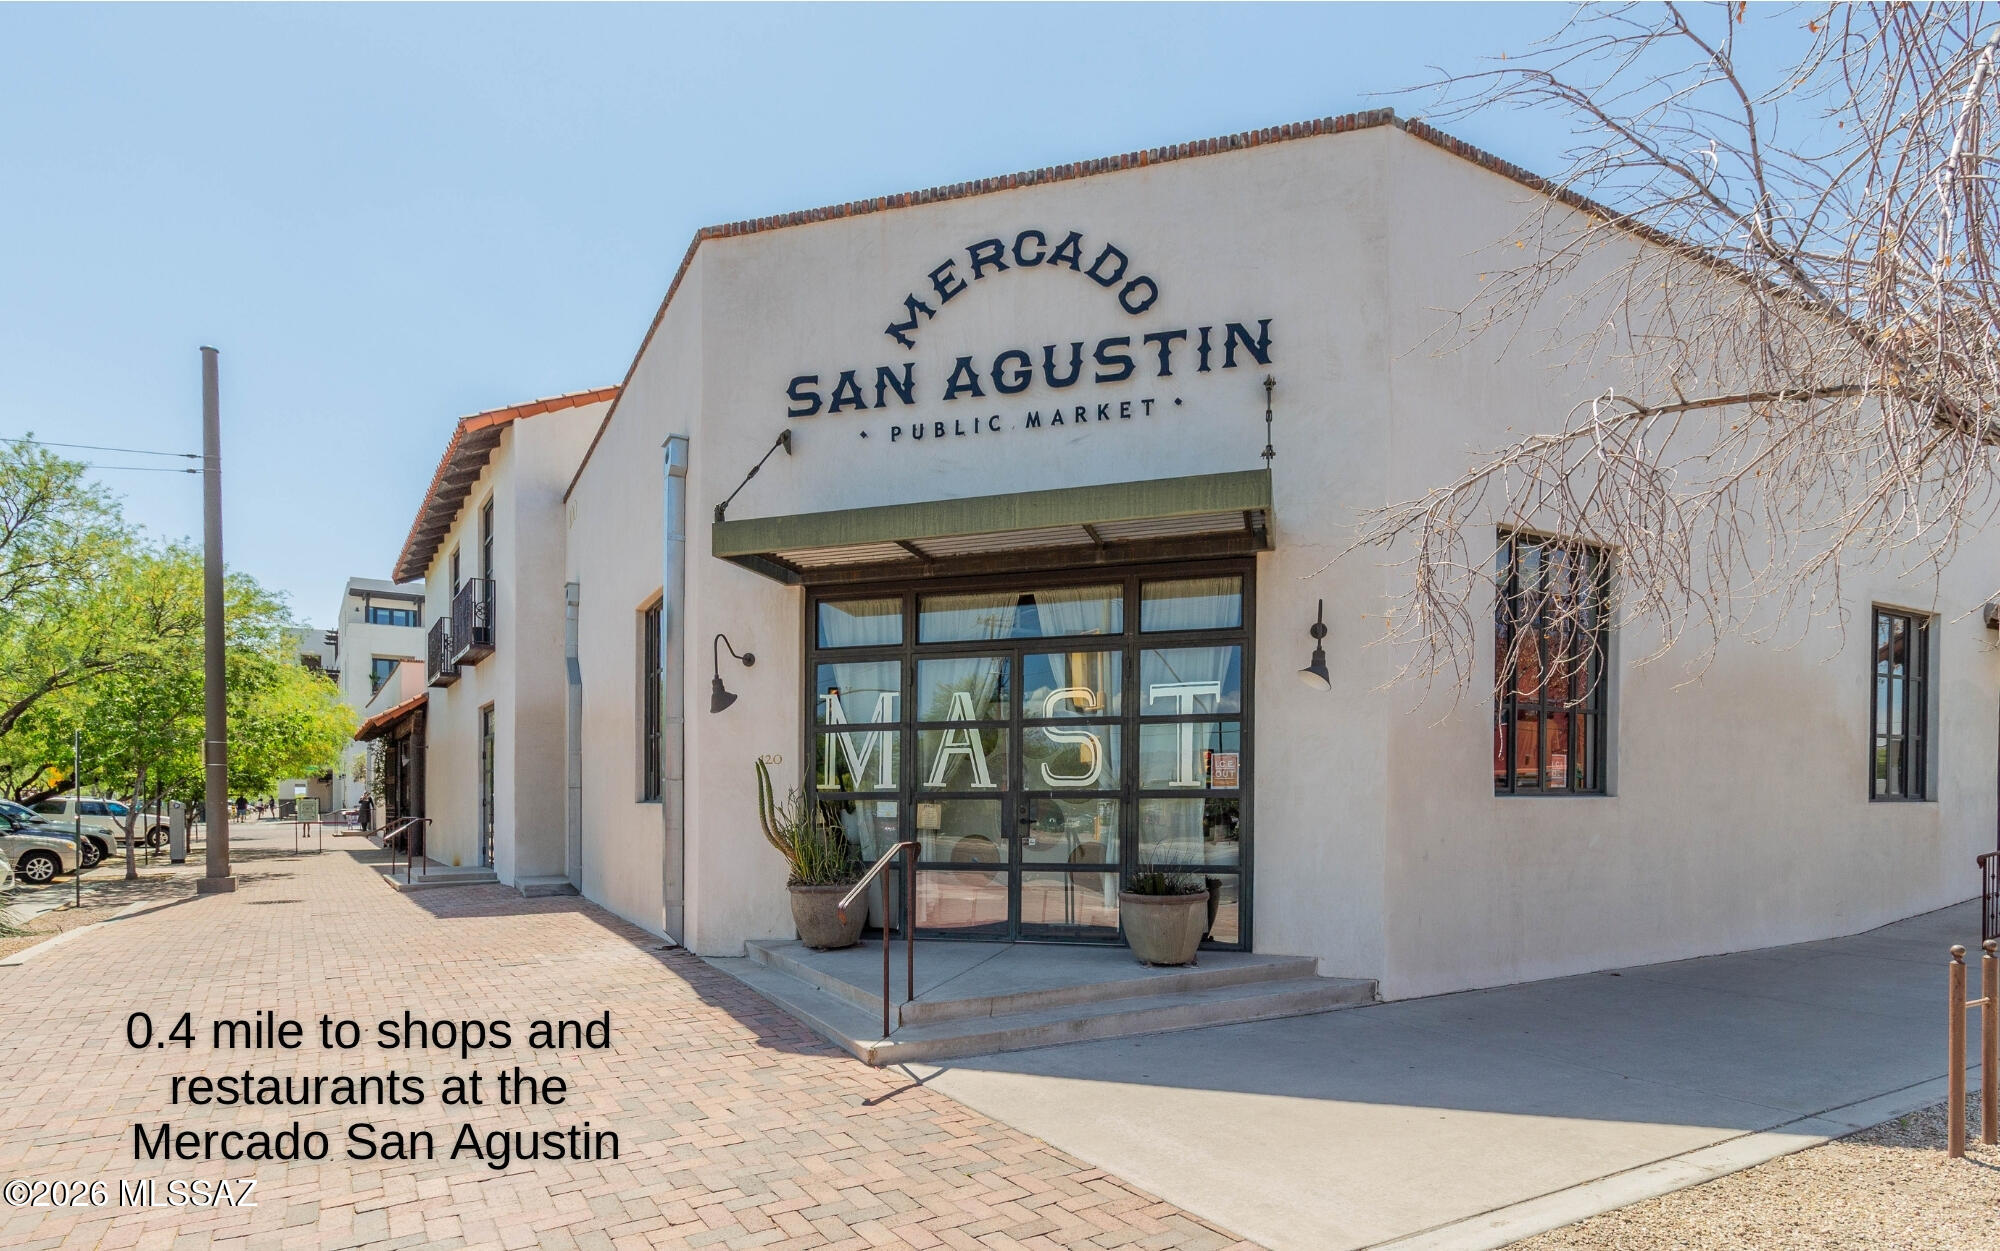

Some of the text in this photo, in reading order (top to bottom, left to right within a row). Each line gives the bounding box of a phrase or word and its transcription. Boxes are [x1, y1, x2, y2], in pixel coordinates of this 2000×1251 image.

[885, 229, 1158, 350] MERCADO
[786, 318, 1273, 418] SAN AGUSTIN
[890, 398, 1155, 442] PUBLIC MARKET
[816, 680, 1221, 789] MAST
[1215, 770, 1235, 778] OUT
